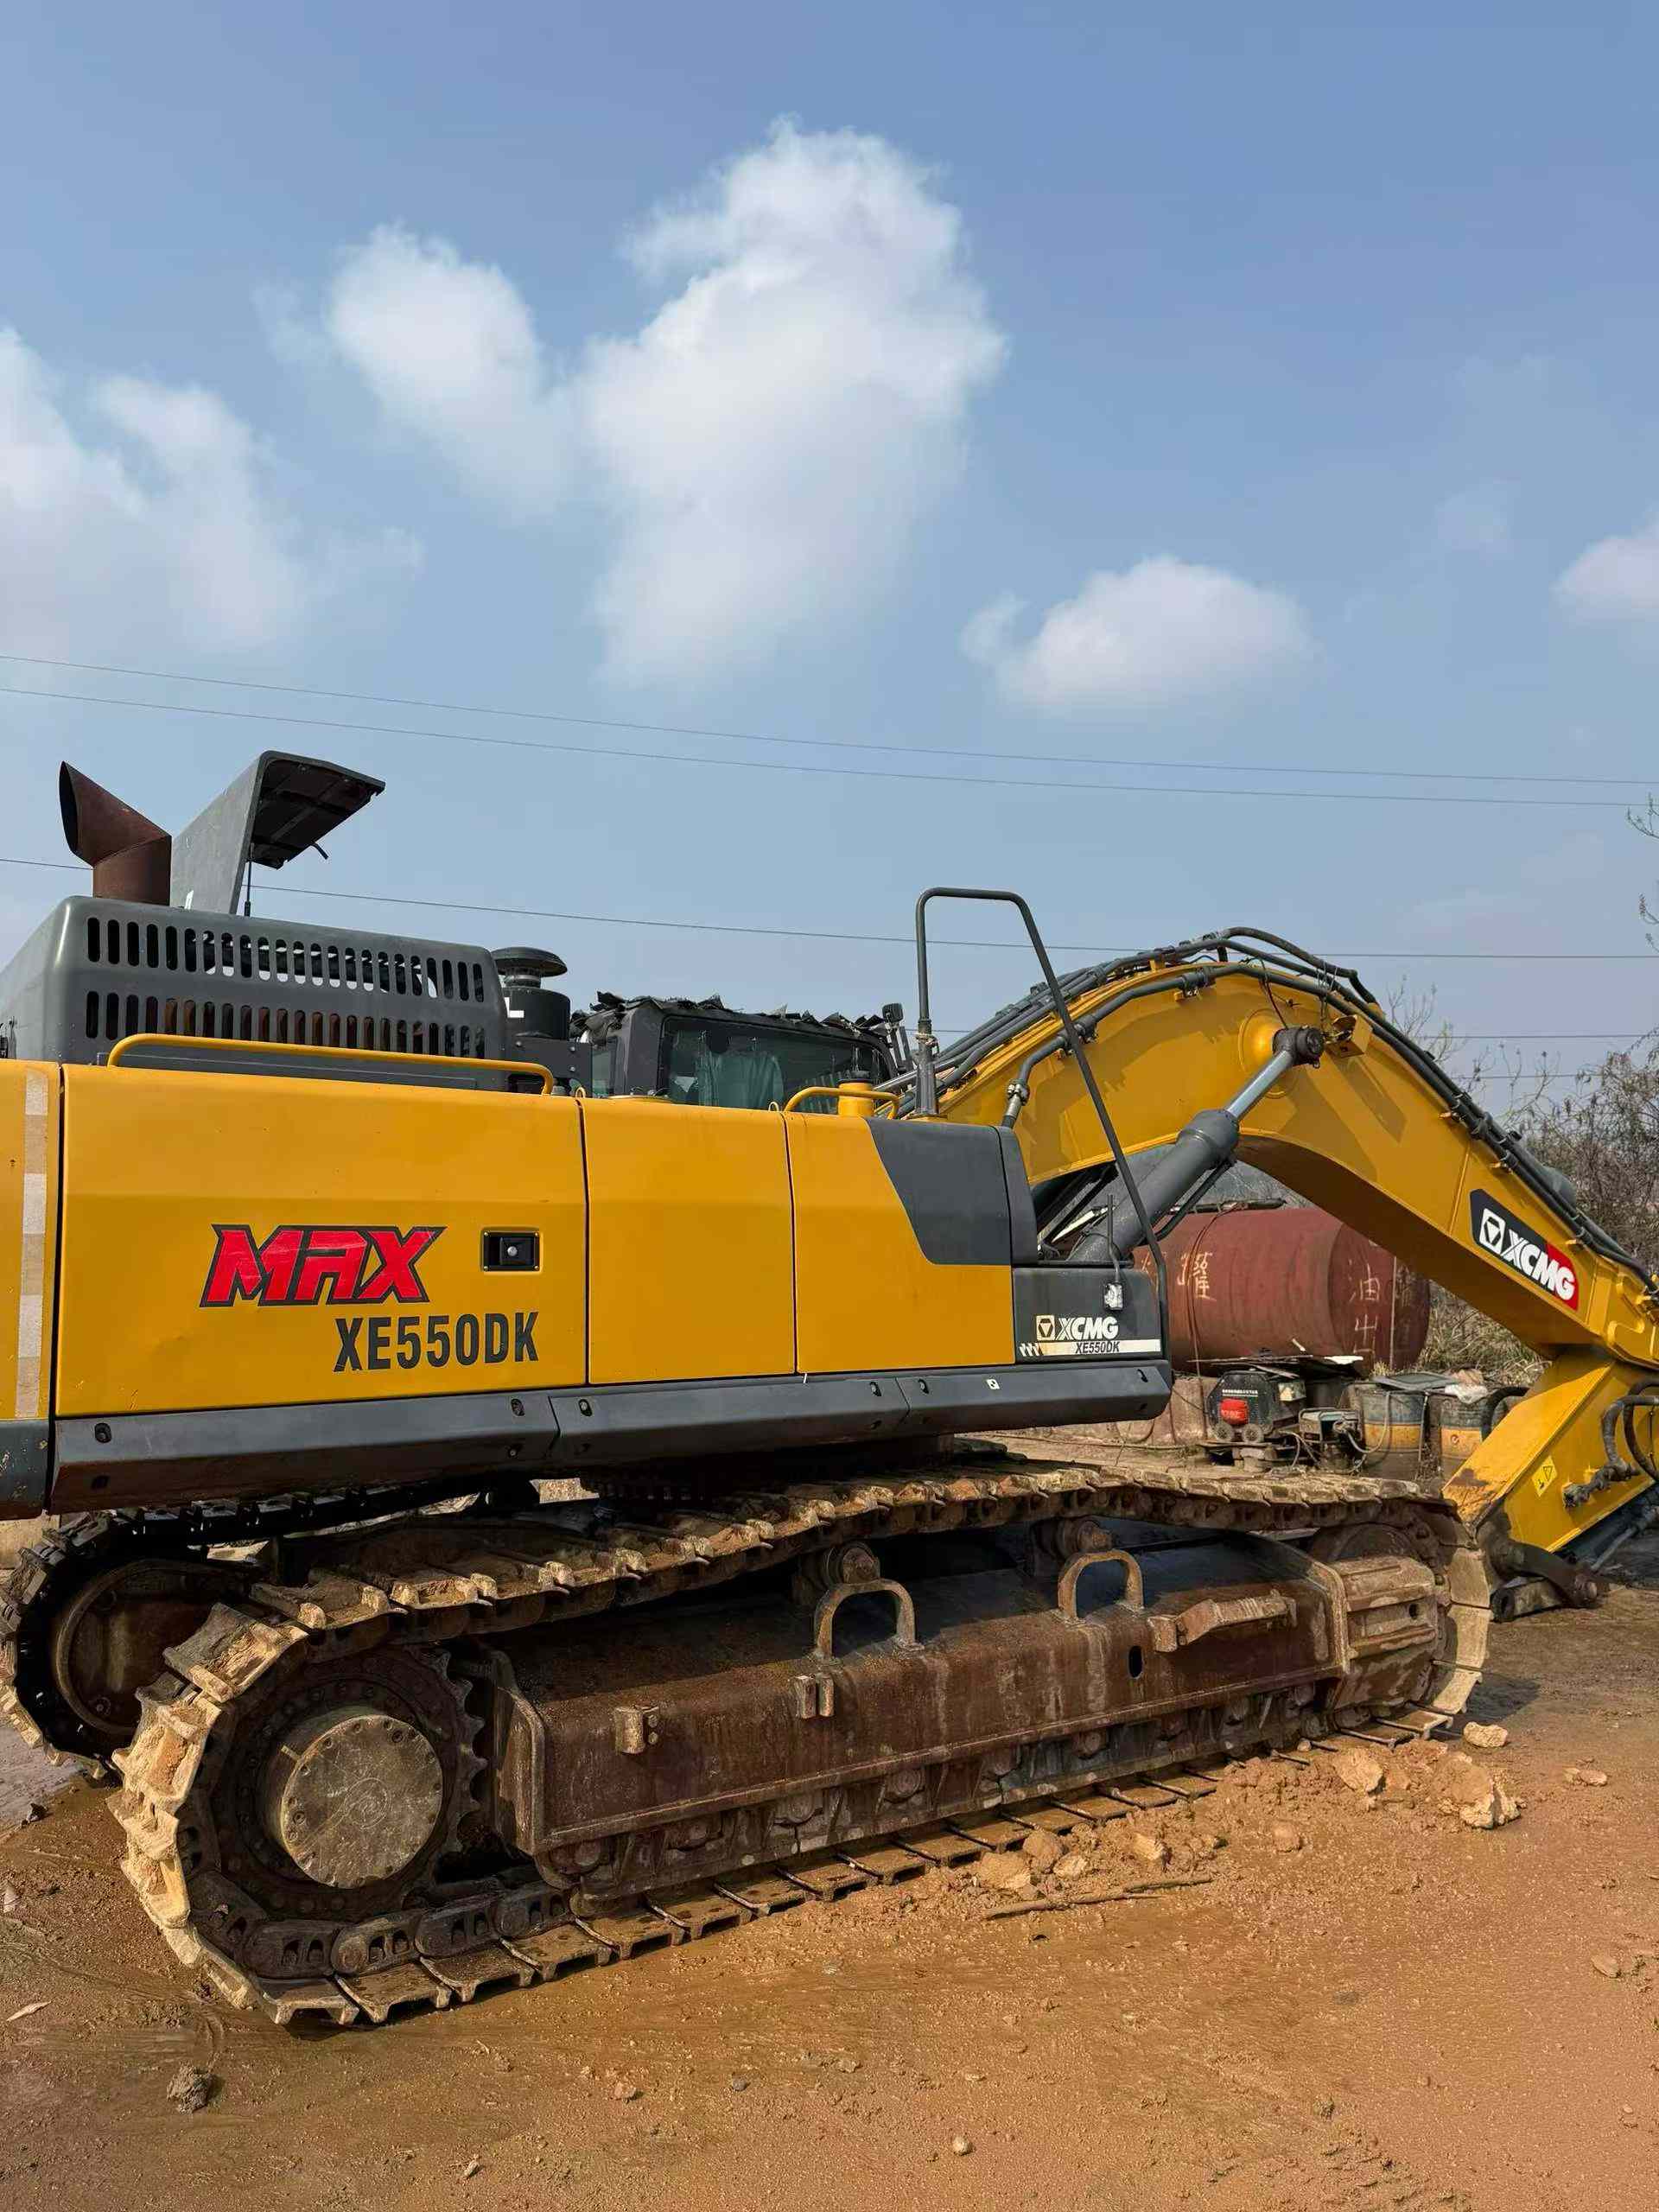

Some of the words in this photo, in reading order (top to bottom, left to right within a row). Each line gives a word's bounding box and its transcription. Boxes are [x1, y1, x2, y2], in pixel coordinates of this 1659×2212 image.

[200, 1224, 448, 1307] MAX
[1500, 1229, 1575, 1300] XCMG
[333, 1312, 539, 1373] XE550DK
[1056, 1316, 1119, 1340] XCMG
[1075, 1341, 1121, 1354] XE550DK
